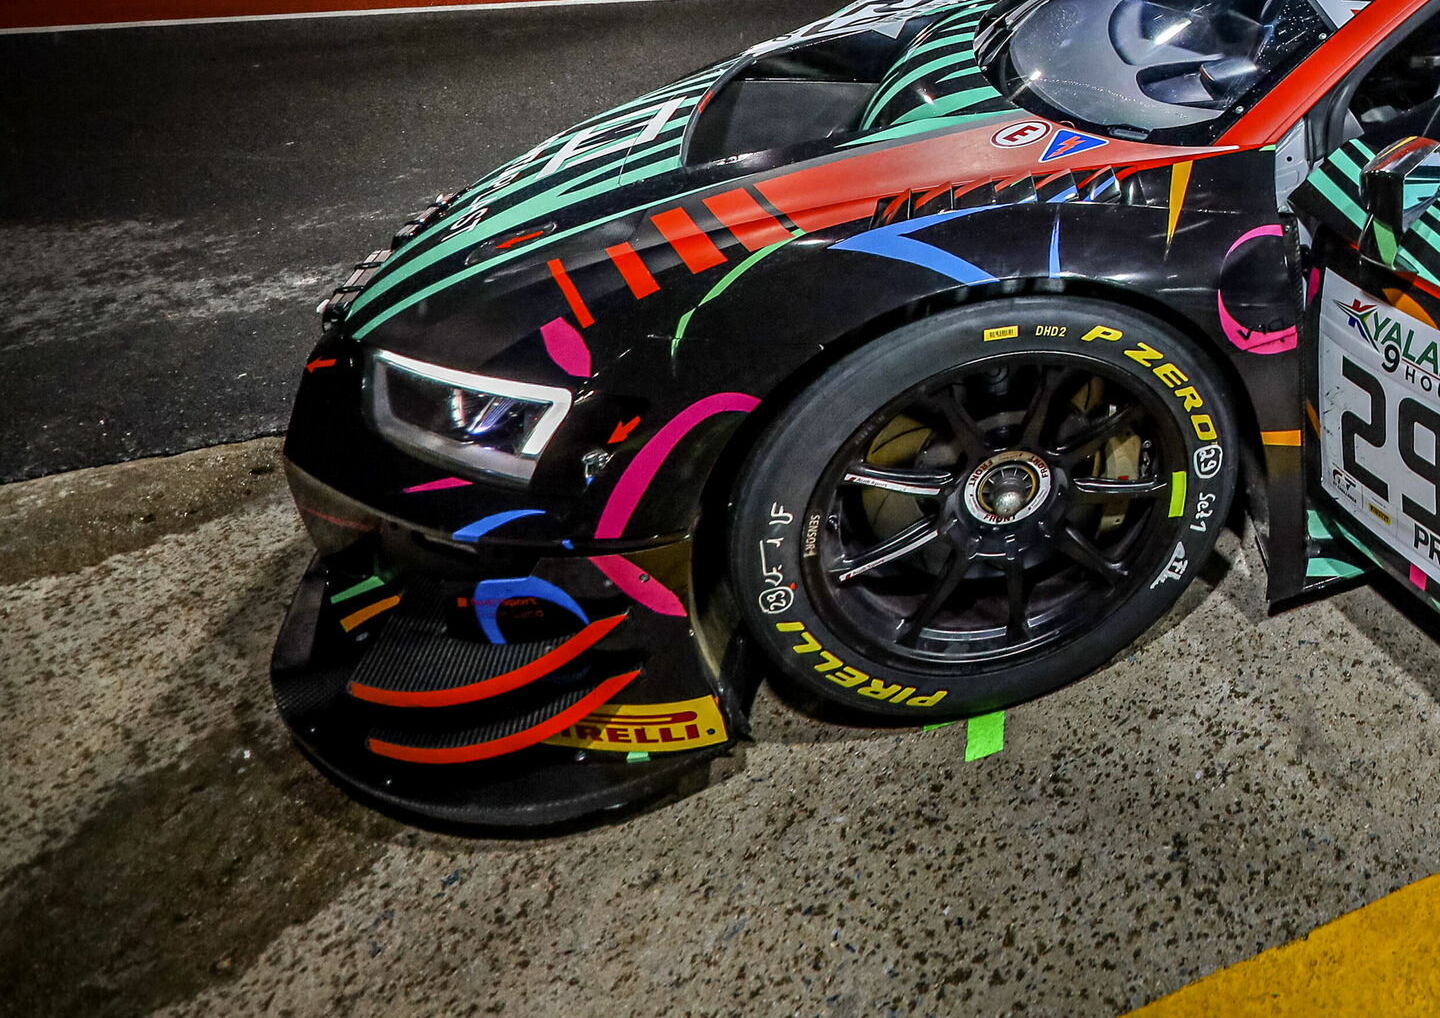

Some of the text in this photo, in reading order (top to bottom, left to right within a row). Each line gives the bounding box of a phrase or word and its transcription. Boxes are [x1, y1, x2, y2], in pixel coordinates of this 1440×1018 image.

[1003, 125, 1040, 142] E
[1034, 324, 1068, 338] DHD2
[1381, 343, 1401, 373] 9
[1081, 325, 1218, 441] P ZERO
[1028, 455, 1049, 479] FRONT
[1199, 447, 1217, 473] 29
[969, 459, 993, 487] FRONT
[767, 590, 786, 611] 29
[775, 621, 948, 707] PIRELLI
[560, 723, 701, 744] IRELLI
